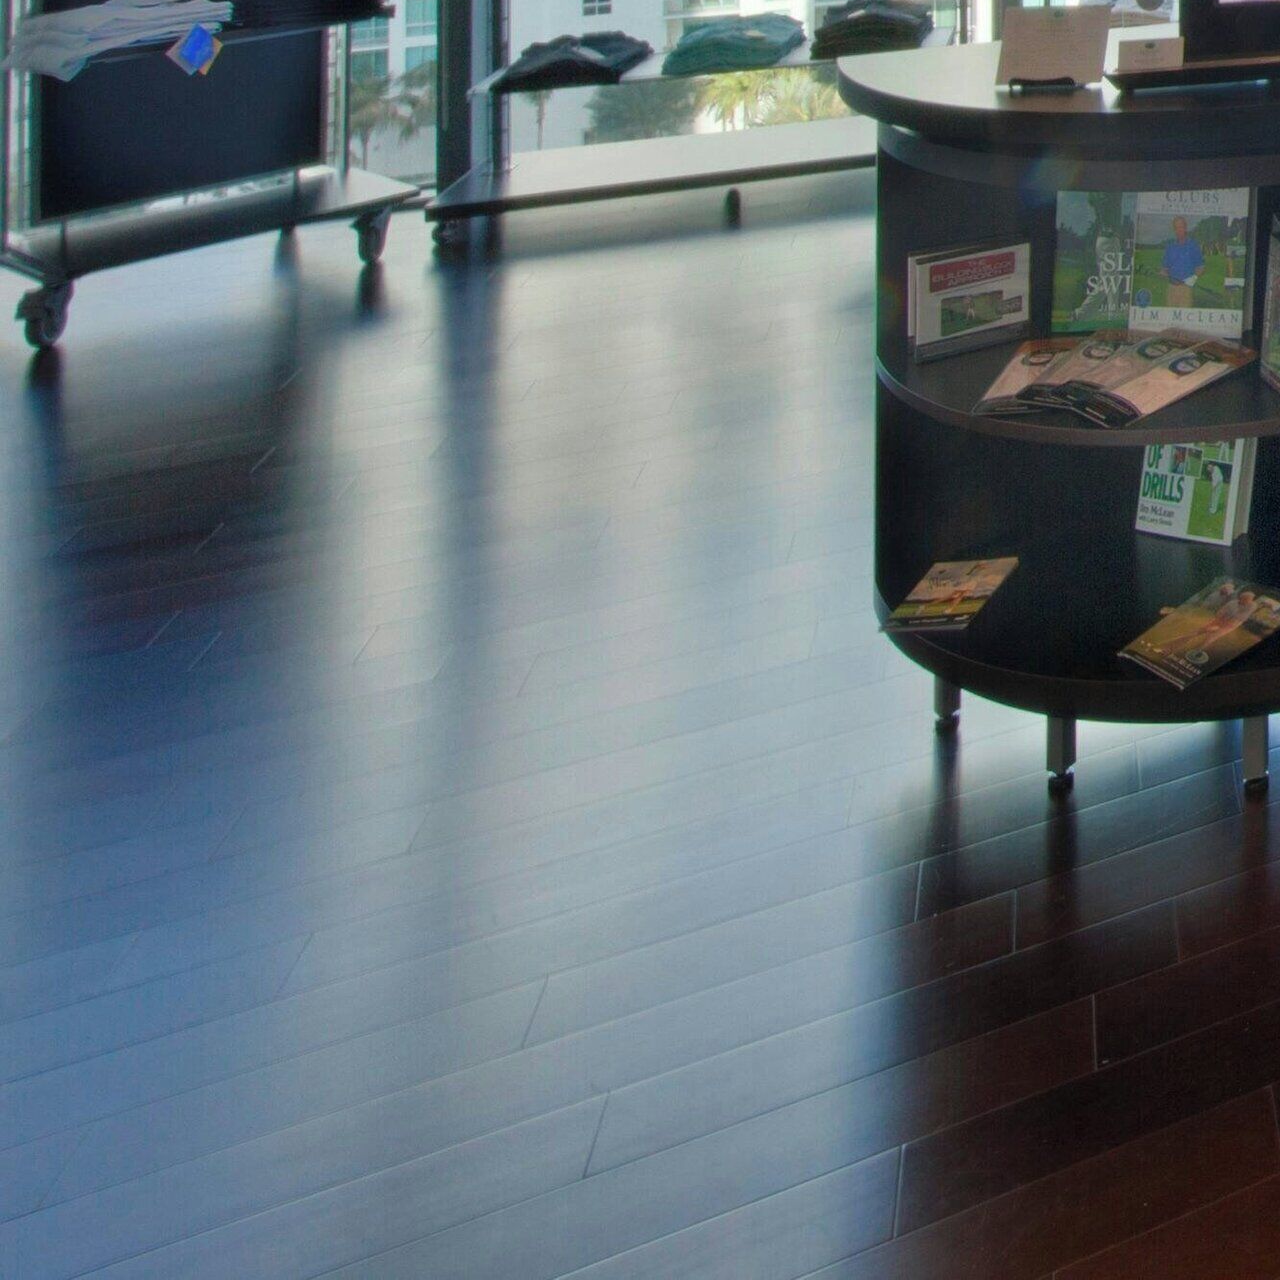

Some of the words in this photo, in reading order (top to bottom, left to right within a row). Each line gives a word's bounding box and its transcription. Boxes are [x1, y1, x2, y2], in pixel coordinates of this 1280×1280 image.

[1102, 252, 1133, 272] SL
[1087, 276, 1131, 295] SWI
[1133, 309, 1159, 321] JIM
[1142, 472, 1185, 503] DRILLS
